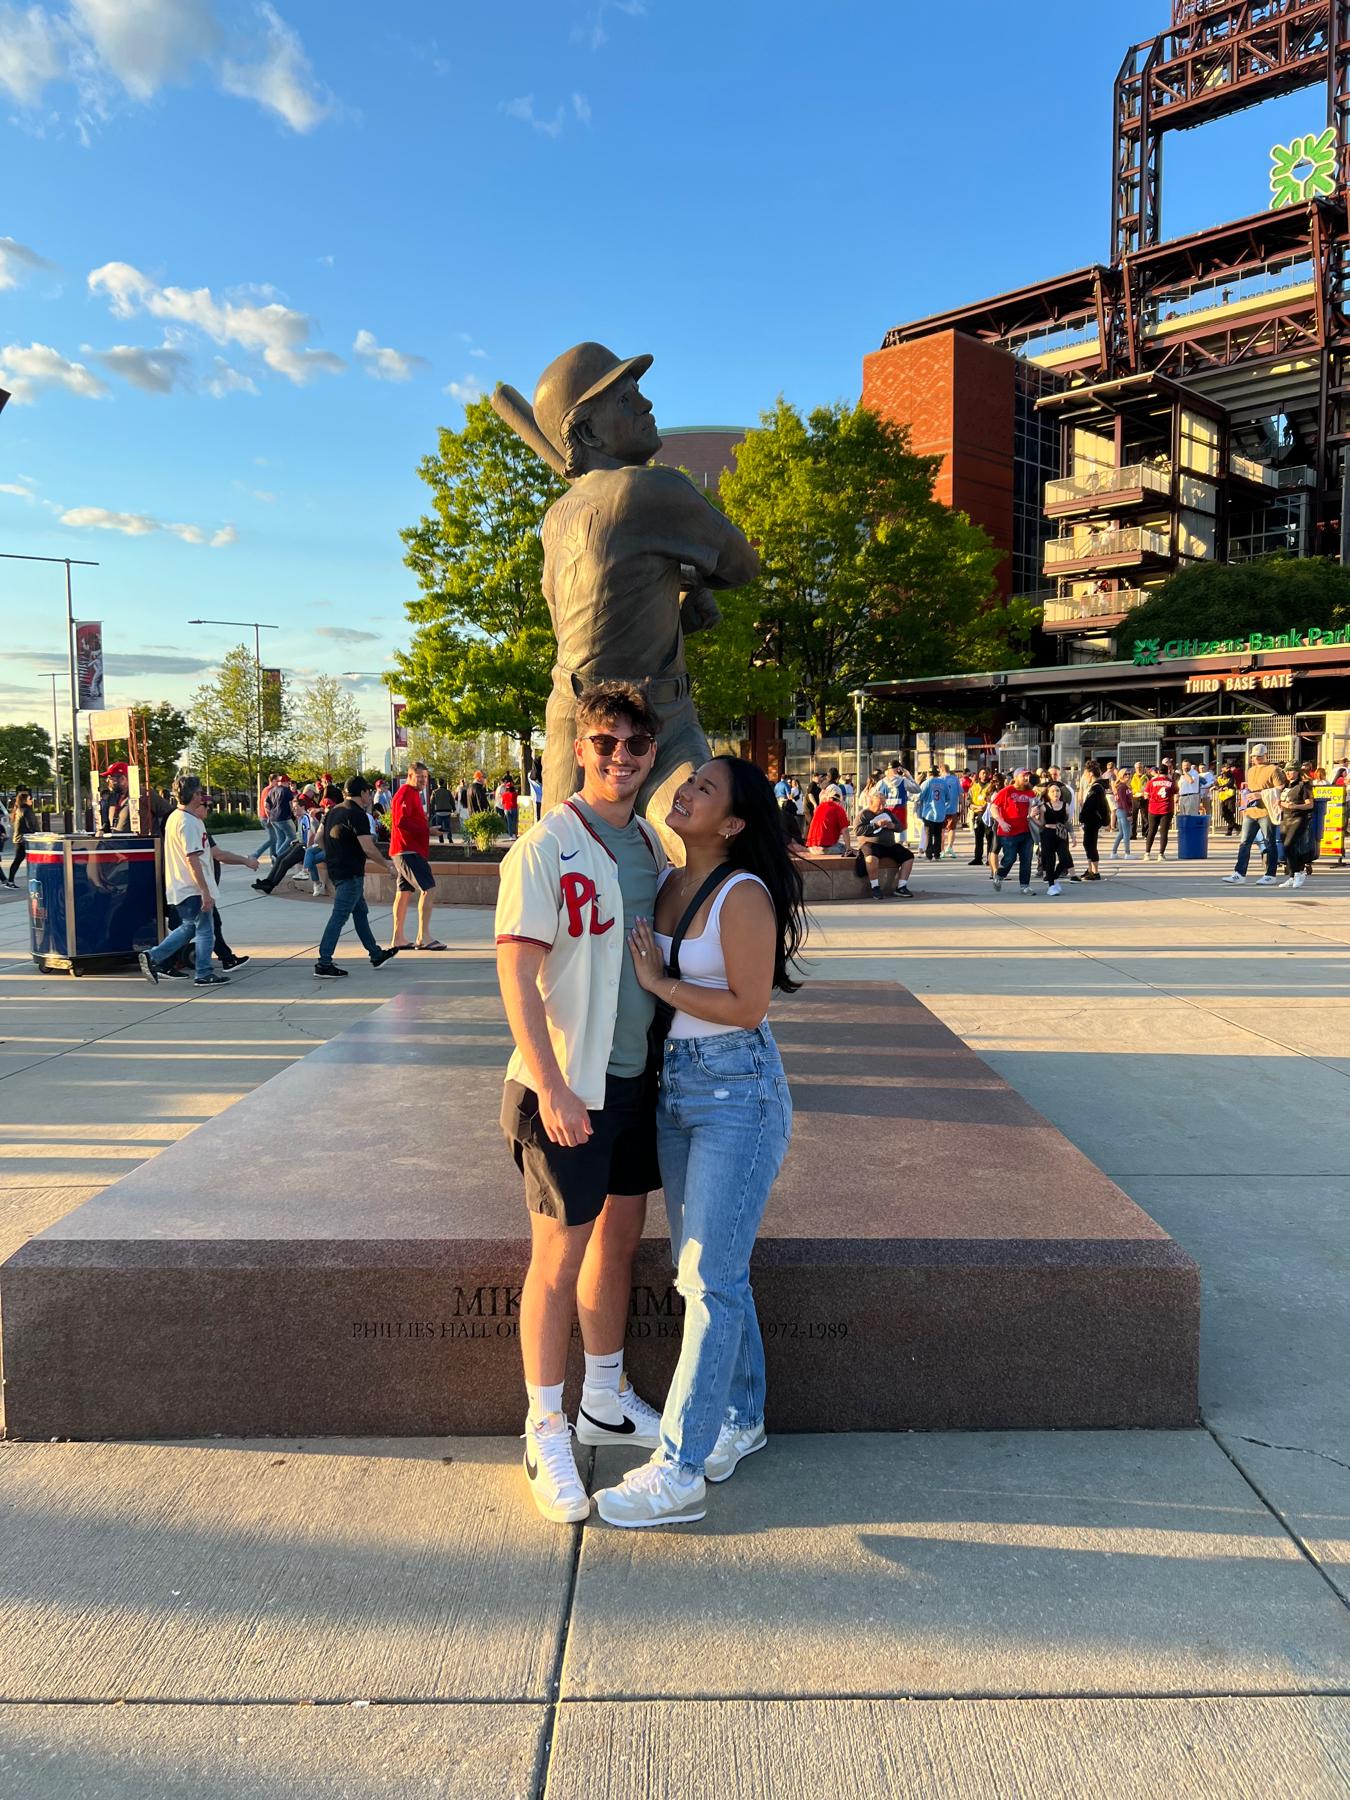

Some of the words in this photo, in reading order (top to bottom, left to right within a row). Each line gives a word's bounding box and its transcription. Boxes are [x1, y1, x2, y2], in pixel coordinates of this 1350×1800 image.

[1163, 637, 1244, 659] Citizens
[1250, 628, 1302, 651] Bank
[1185, 680, 1220, 693] THIRD
[1225, 677, 1256, 691] BASE
[1262, 674, 1294, 688] GATE
[453, 1286, 523, 1317] MIK
[353, 1322, 435, 1338] PHILLIES
[440, 1322, 491, 1338] HALL
